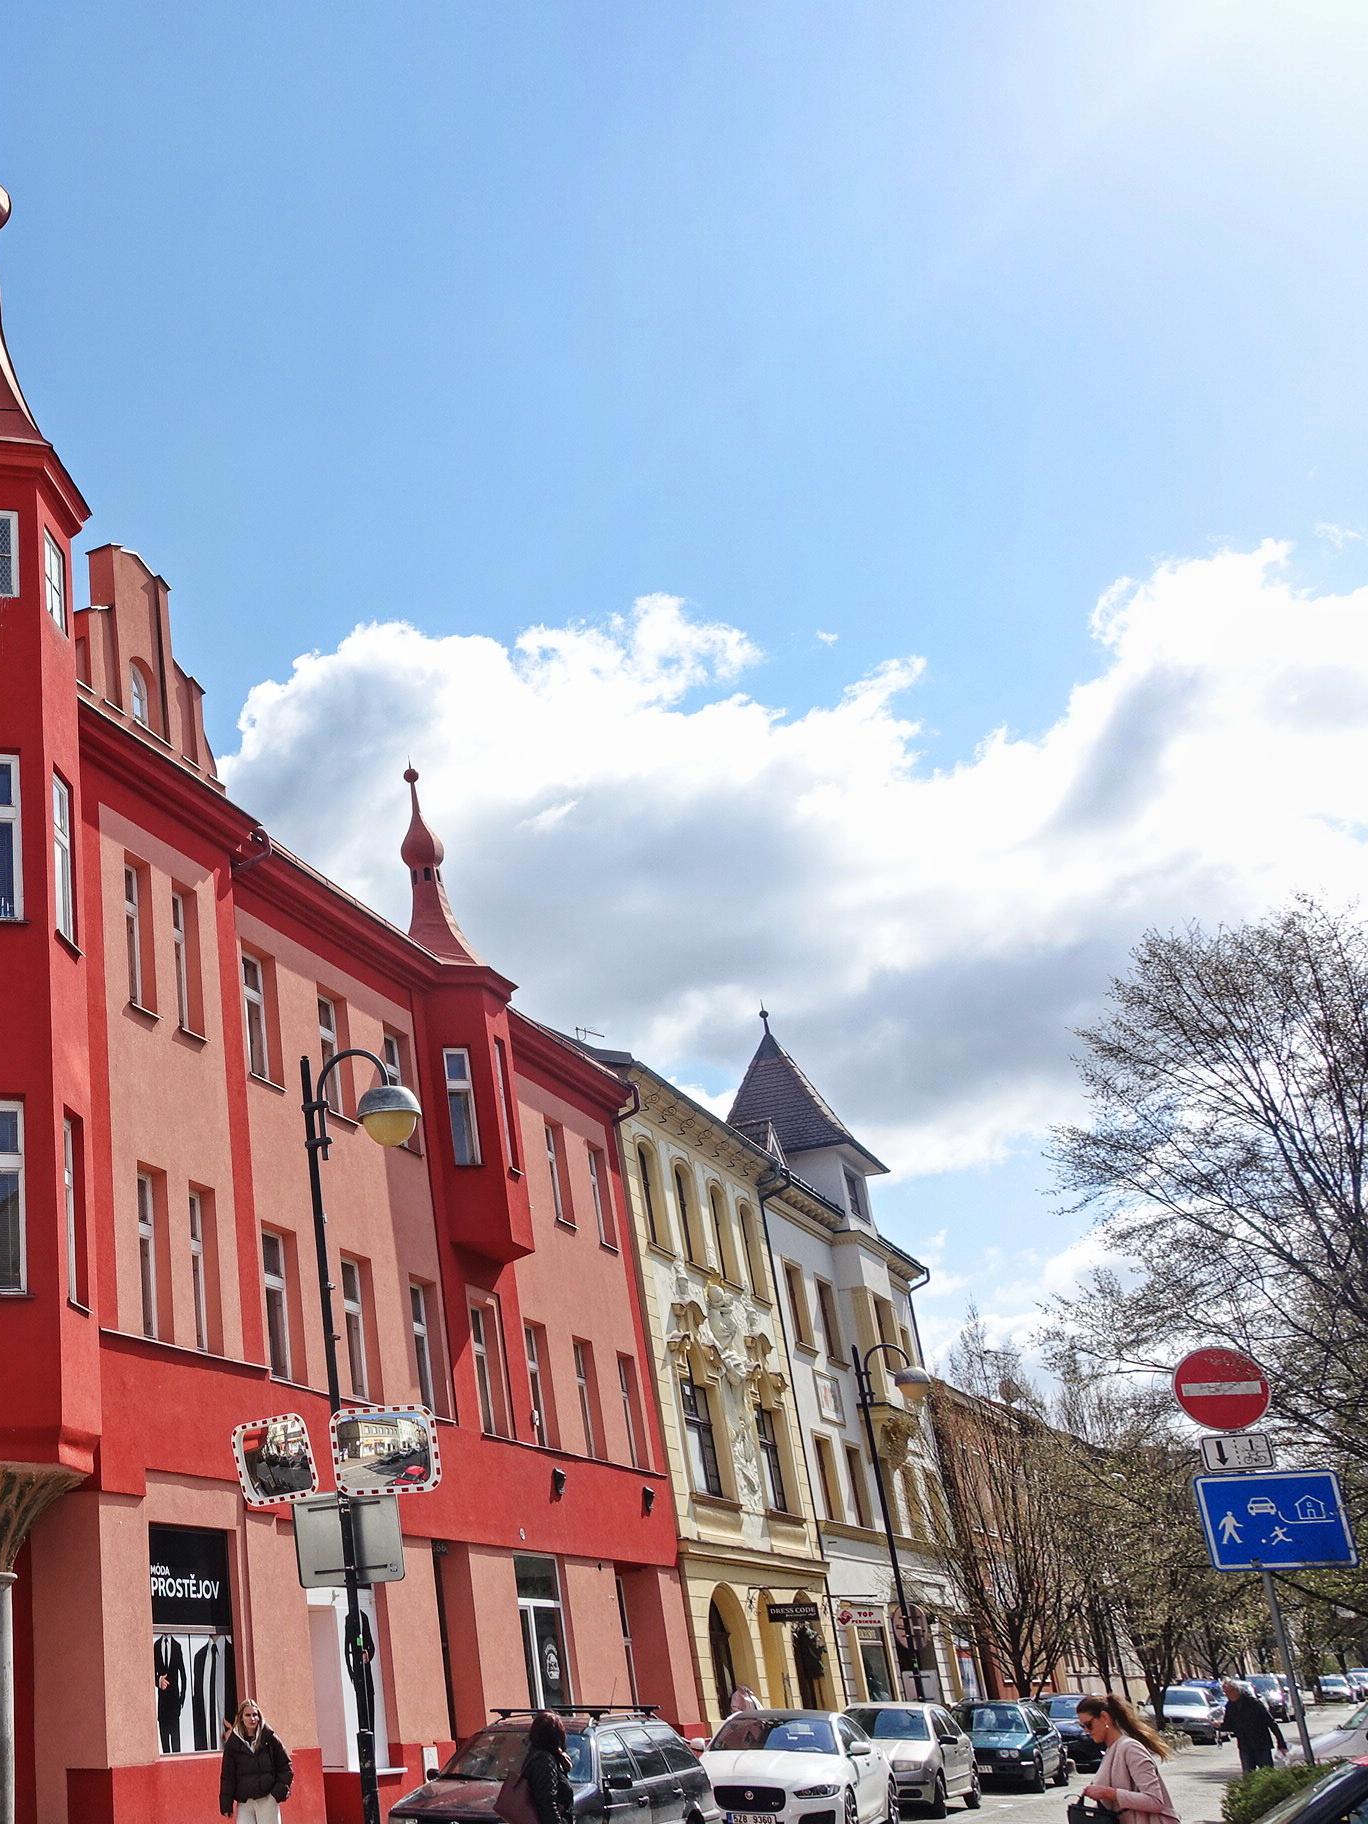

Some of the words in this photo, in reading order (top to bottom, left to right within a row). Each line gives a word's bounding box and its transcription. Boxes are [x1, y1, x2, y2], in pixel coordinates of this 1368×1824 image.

[150, 1562, 171, 1576] MÓDA
[150, 1573, 220, 1599] PROSTĚJOV
[794, 1606, 817, 1614] CODE
[733, 1814, 748, 1824] 5Z8
[752, 1815, 773, 1824] 9360
